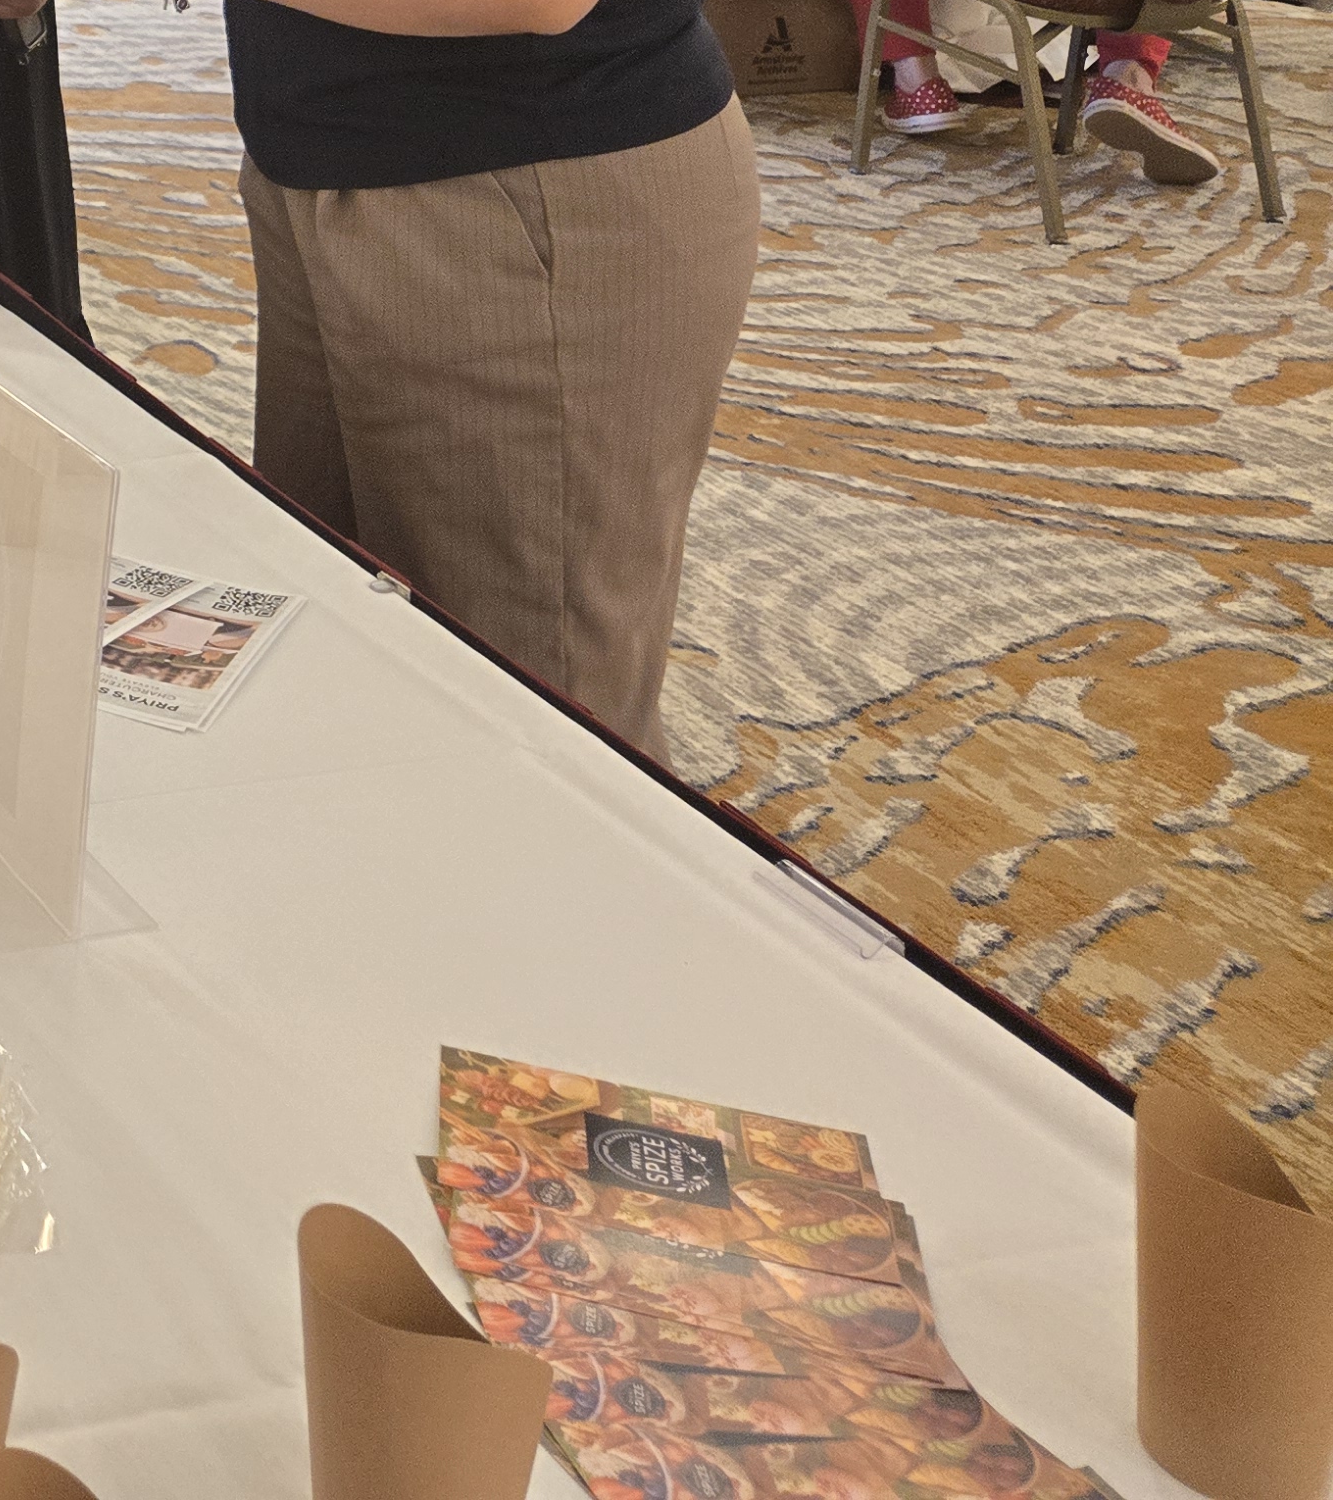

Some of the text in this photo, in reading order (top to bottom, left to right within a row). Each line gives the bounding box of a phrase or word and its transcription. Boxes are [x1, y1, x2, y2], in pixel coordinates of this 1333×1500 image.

[100, 678, 176, 700] CHARCUTER
[112, 690, 179, 711] PRIYA'S
[642, 1136, 669, 1185] SPIZE
[668, 1147, 684, 1181] WORKS
[586, 1304, 597, 1333] SPIZE
[633, 1383, 646, 1414] SPIZE
